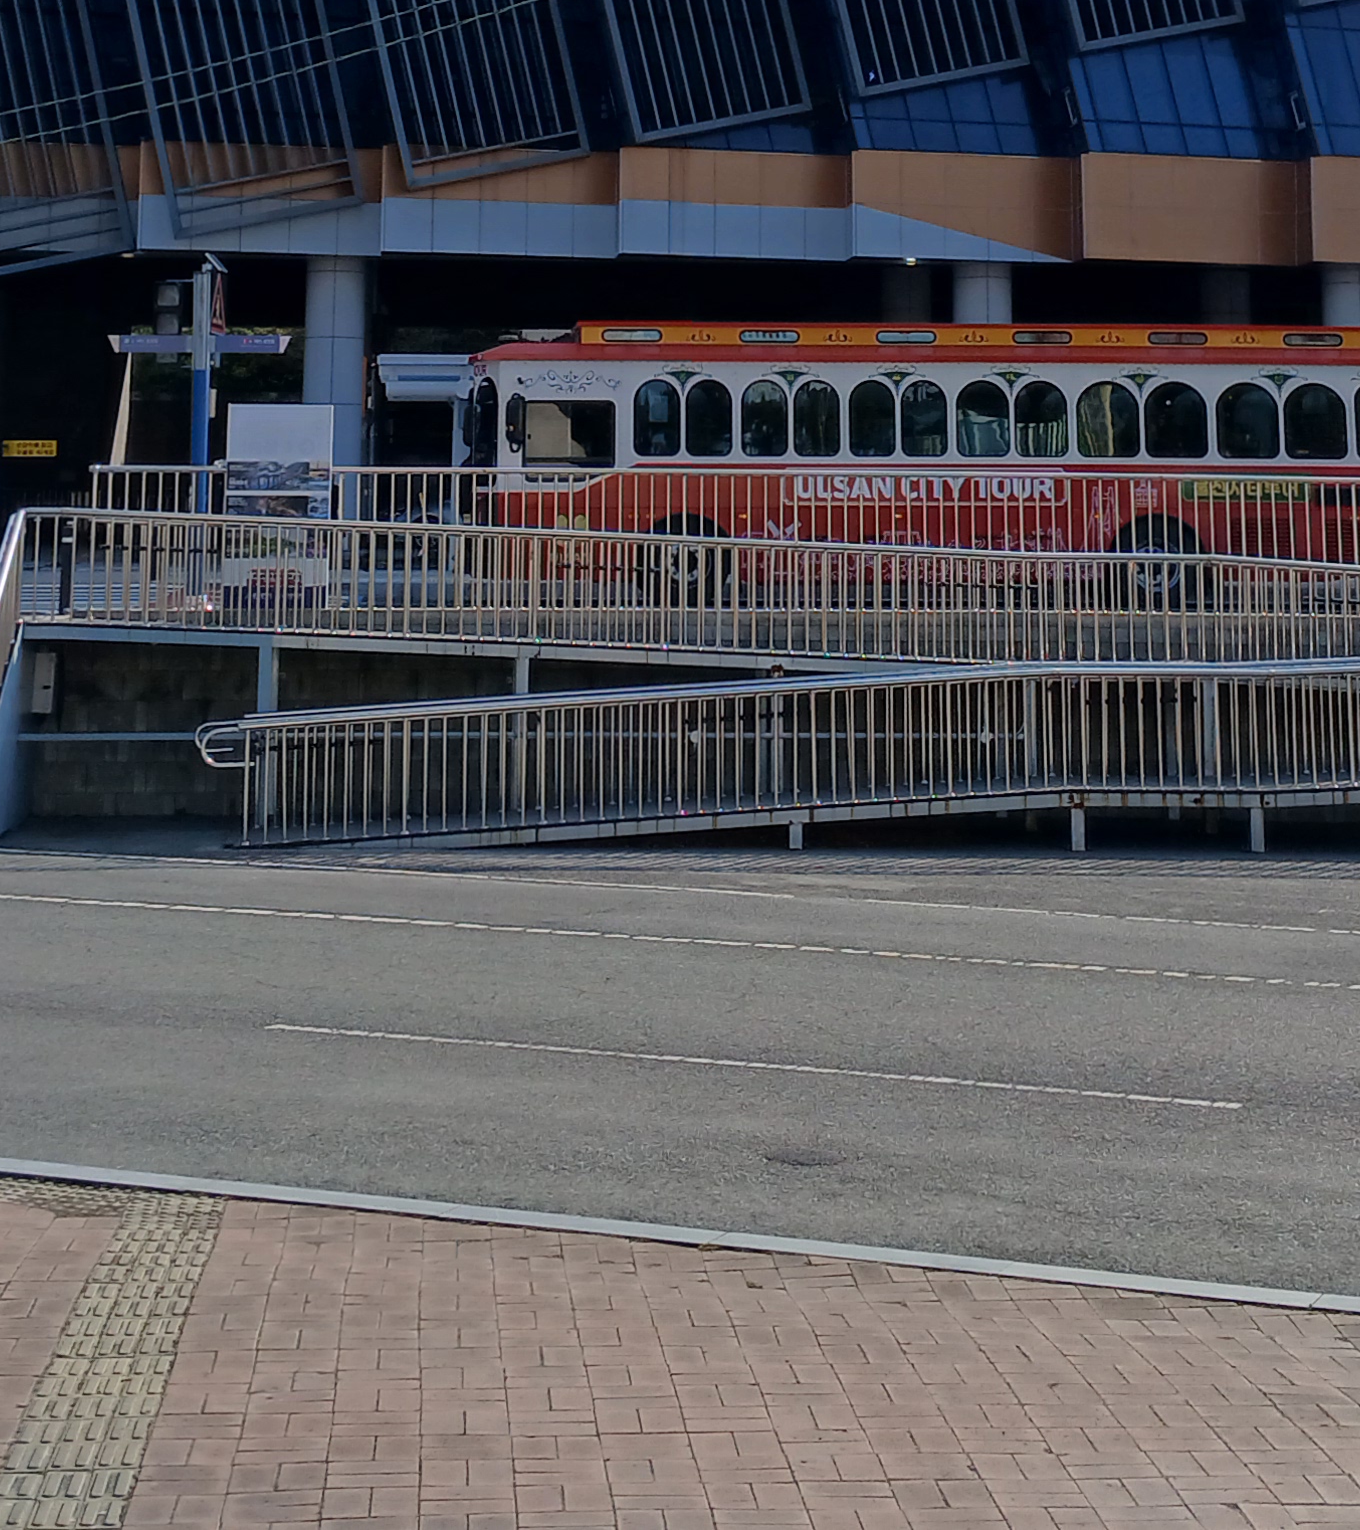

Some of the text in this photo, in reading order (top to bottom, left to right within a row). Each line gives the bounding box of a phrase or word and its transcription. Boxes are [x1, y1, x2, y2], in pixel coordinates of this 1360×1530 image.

[797, 475, 1055, 500] ULSAN CITY TOUR
